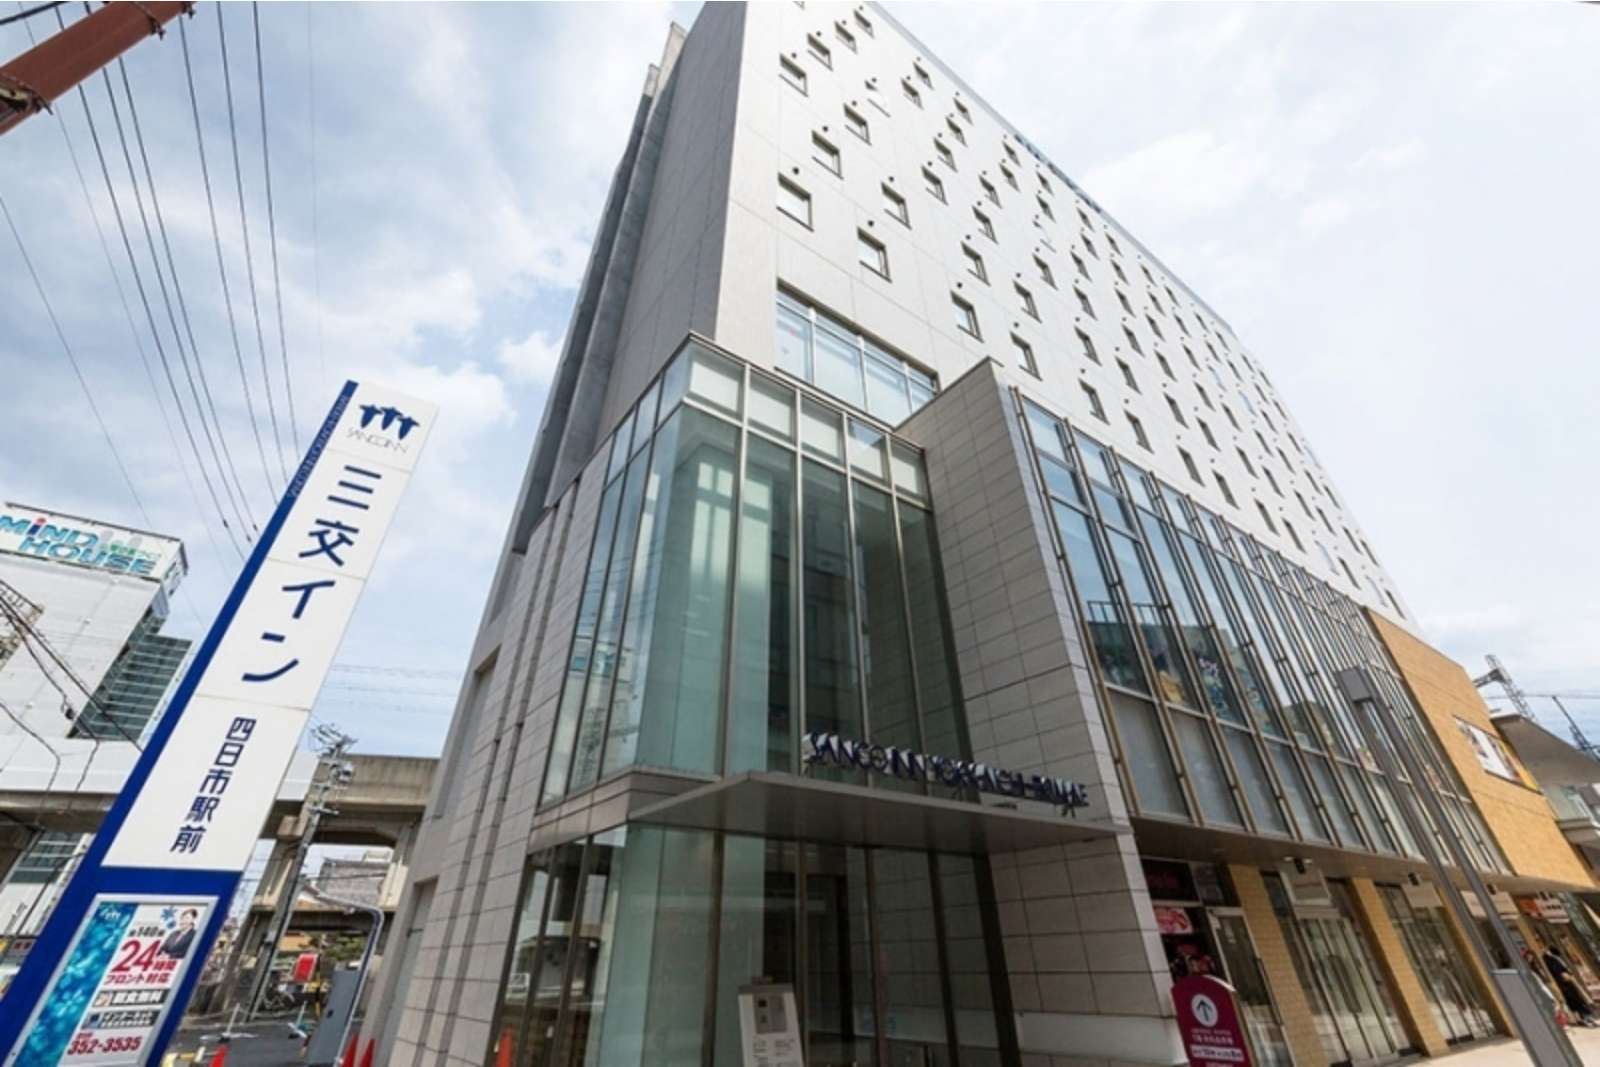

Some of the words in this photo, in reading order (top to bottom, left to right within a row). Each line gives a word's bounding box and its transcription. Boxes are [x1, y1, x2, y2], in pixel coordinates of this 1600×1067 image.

[18, 537, 156, 575] HOUSE
[241, 464, 382, 682] 三交イン
[170, 716, 257, 854] 四日市駅前
[67, 1035, 143, 1056] 352-3535
